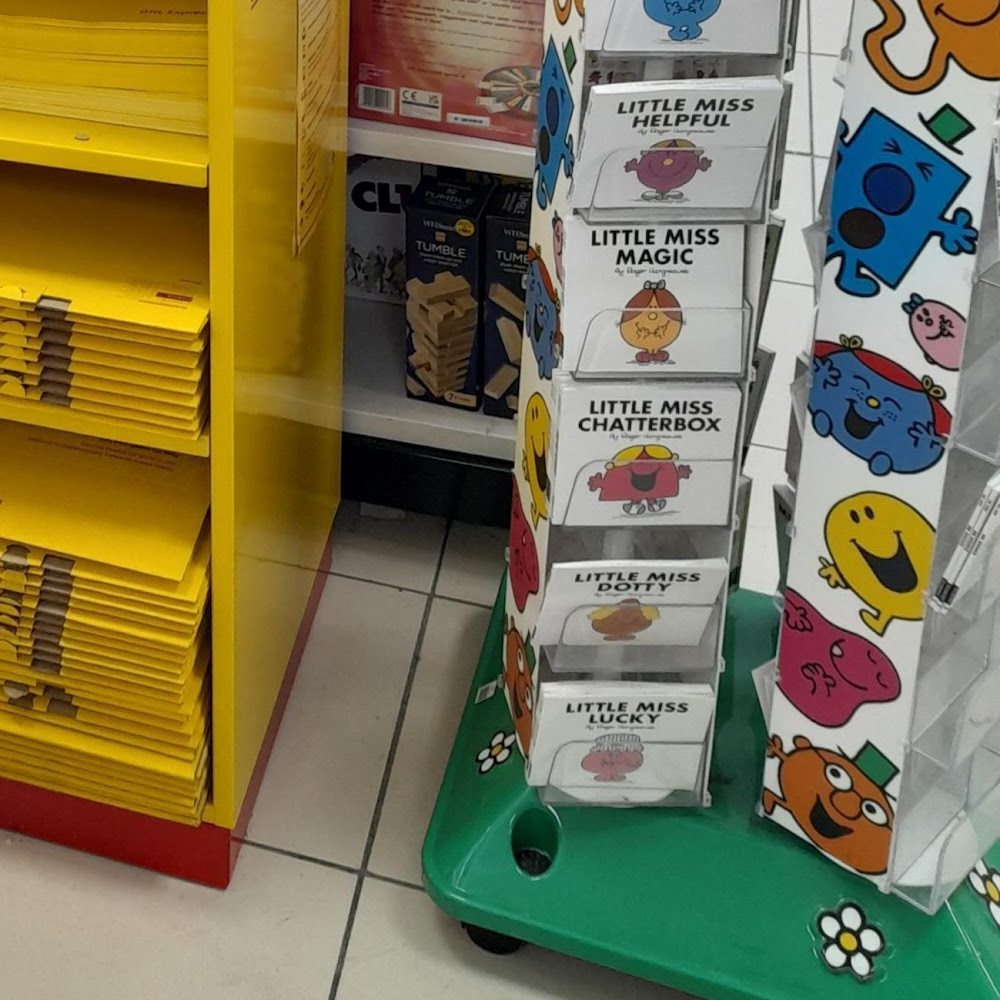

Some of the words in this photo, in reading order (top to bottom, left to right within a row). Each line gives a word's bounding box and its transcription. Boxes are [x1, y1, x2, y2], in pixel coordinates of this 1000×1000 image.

[617, 99, 686, 114] LITTLE
[694, 99, 755, 112] MISS
[632, 114, 731, 128] HELPFUL
[591, 229, 655, 246] LITTLE
[664, 229, 720, 245] MISS
[415, 240, 467, 259] TUMBLE
[616, 249, 693, 265] MAGIC
[589, 400, 652, 414] LITTLE
[660, 401, 713, 415] MISS
[578, 417, 722, 432] CHATTERBOX
[575, 573, 639, 582] LITTLE
[649, 573, 701, 582] MISS
[597, 583, 671, 592] DOTTY
[566, 702, 628, 713] LITTLE
[636, 702, 689, 713] MISS
[589, 714, 661, 724] LUCKY
